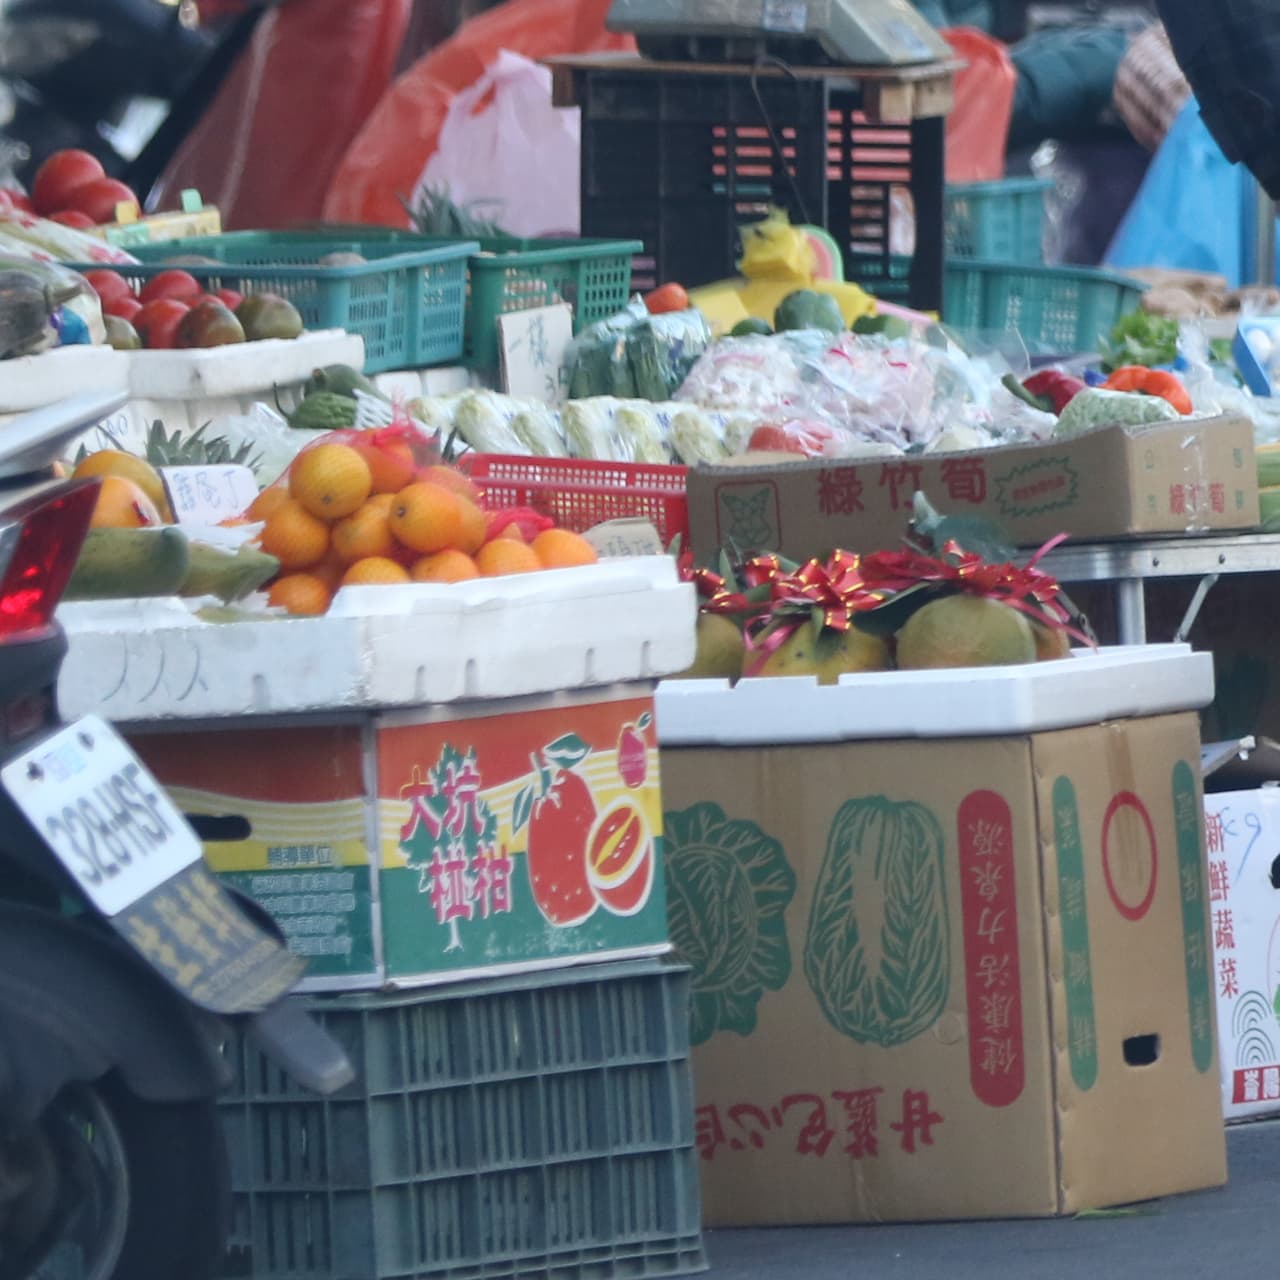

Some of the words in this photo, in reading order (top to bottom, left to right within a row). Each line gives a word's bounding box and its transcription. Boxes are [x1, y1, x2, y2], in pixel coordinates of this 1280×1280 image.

[817, 456, 988, 518] 綠竹筍
[400, 758, 484, 841] 大坑
[967, 817, 1018, 1076] 健康活力泉源
[1205, 810, 1239, 1001] 新鮮蔬菜
